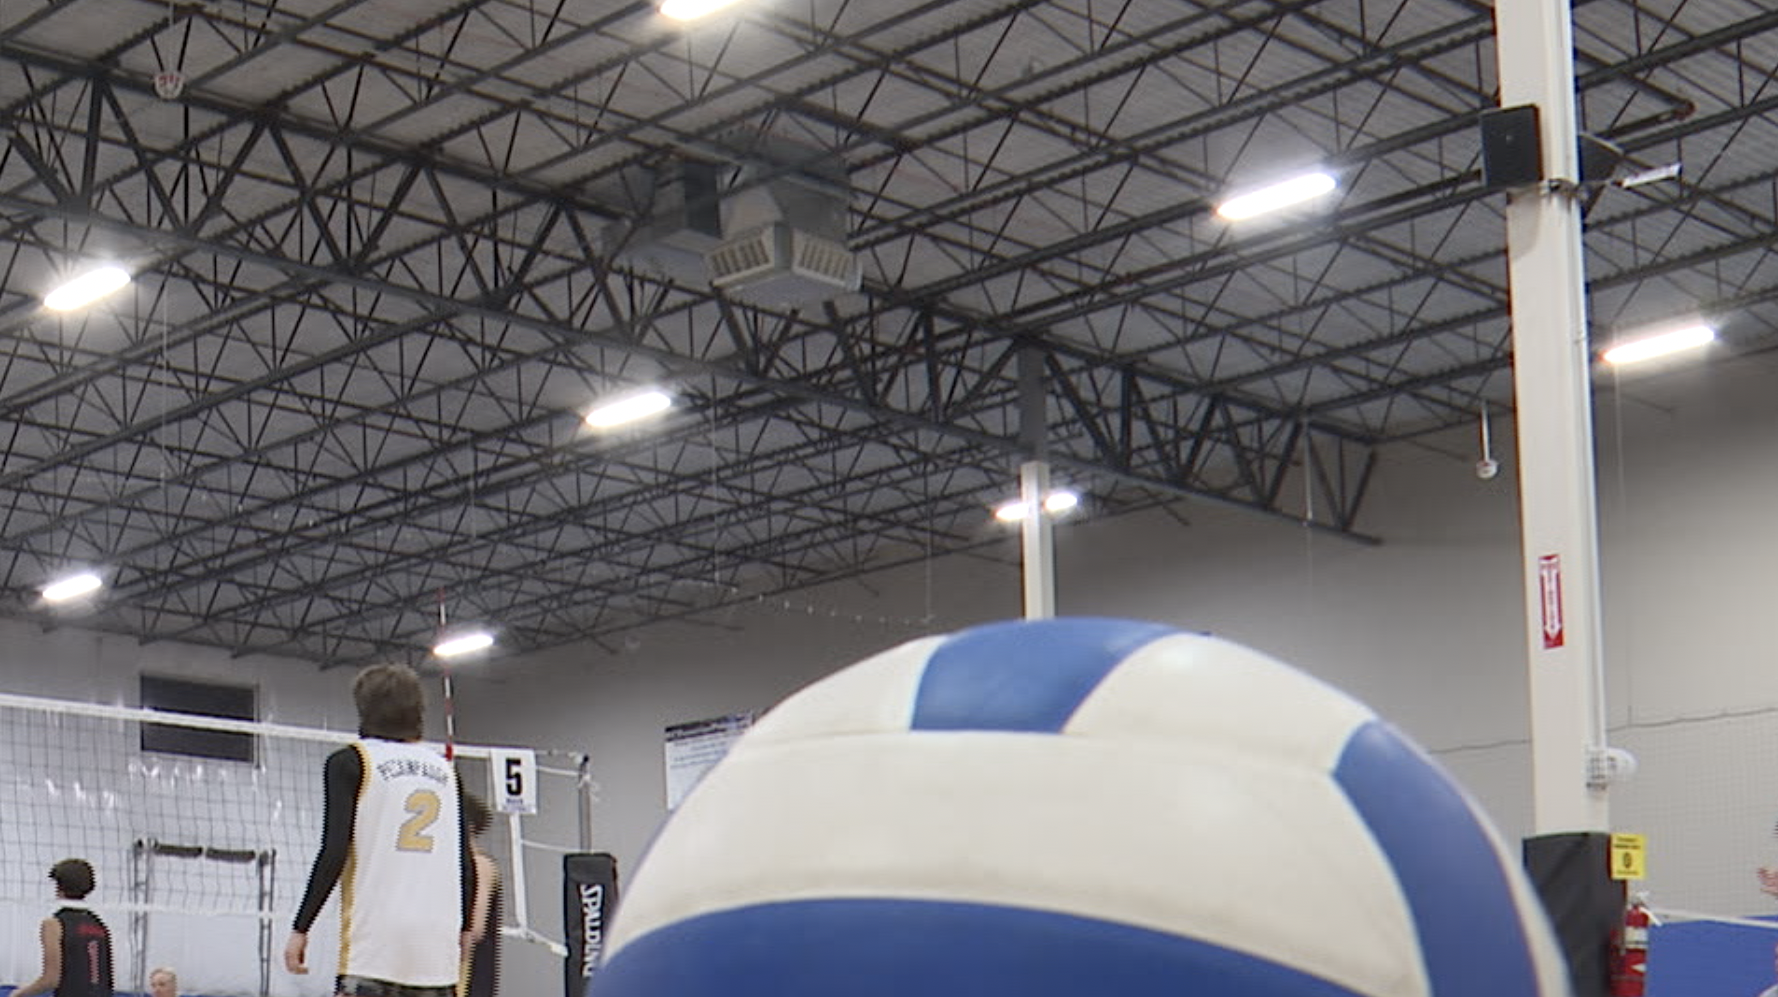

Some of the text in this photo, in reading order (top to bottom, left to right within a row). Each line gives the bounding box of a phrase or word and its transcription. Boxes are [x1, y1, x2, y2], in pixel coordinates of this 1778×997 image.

[505, 758, 522, 796] 5
[396, 789, 441, 853] 2
[87, 940, 99, 984] 1
